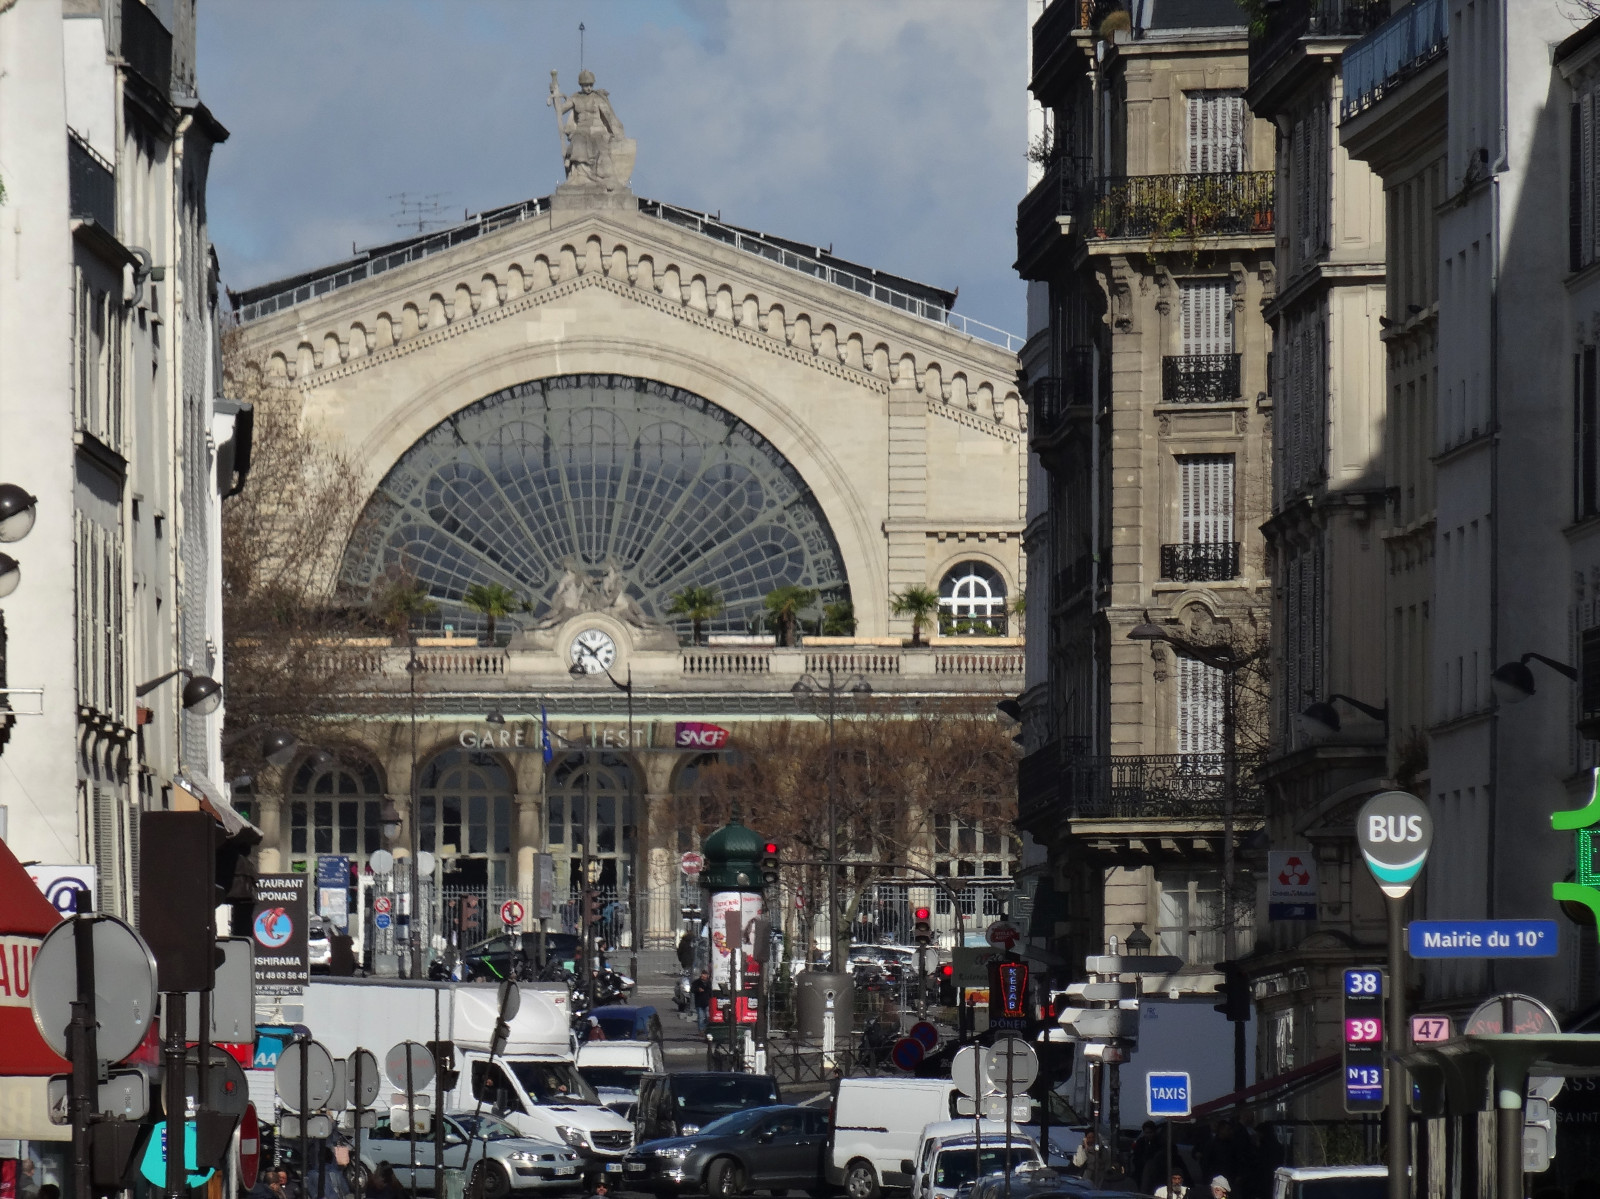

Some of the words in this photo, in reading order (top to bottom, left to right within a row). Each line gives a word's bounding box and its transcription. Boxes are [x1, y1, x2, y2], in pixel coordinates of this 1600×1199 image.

[459, 729, 525, 748] GARE
[676, 729, 725, 747] SNCF
[1369, 815, 1423, 843] BUS
[256, 879, 304, 889] TAURANT
[1424, 931, 1482, 948] Mairie
[1487, 931, 1510, 947] du
[0, 943, 40, 998] AU
[1008, 968, 1017, 1009] KEBAB
[1350, 973, 1377, 993] 38
[990, 1018, 1027, 1029] DÖNER
[1350, 1020, 1378, 1040] 39
[1418, 1020, 1445, 1039] 47
[1349, 1068, 1379, 1084] N13
[1151, 1088, 1187, 1100] TAXIS
